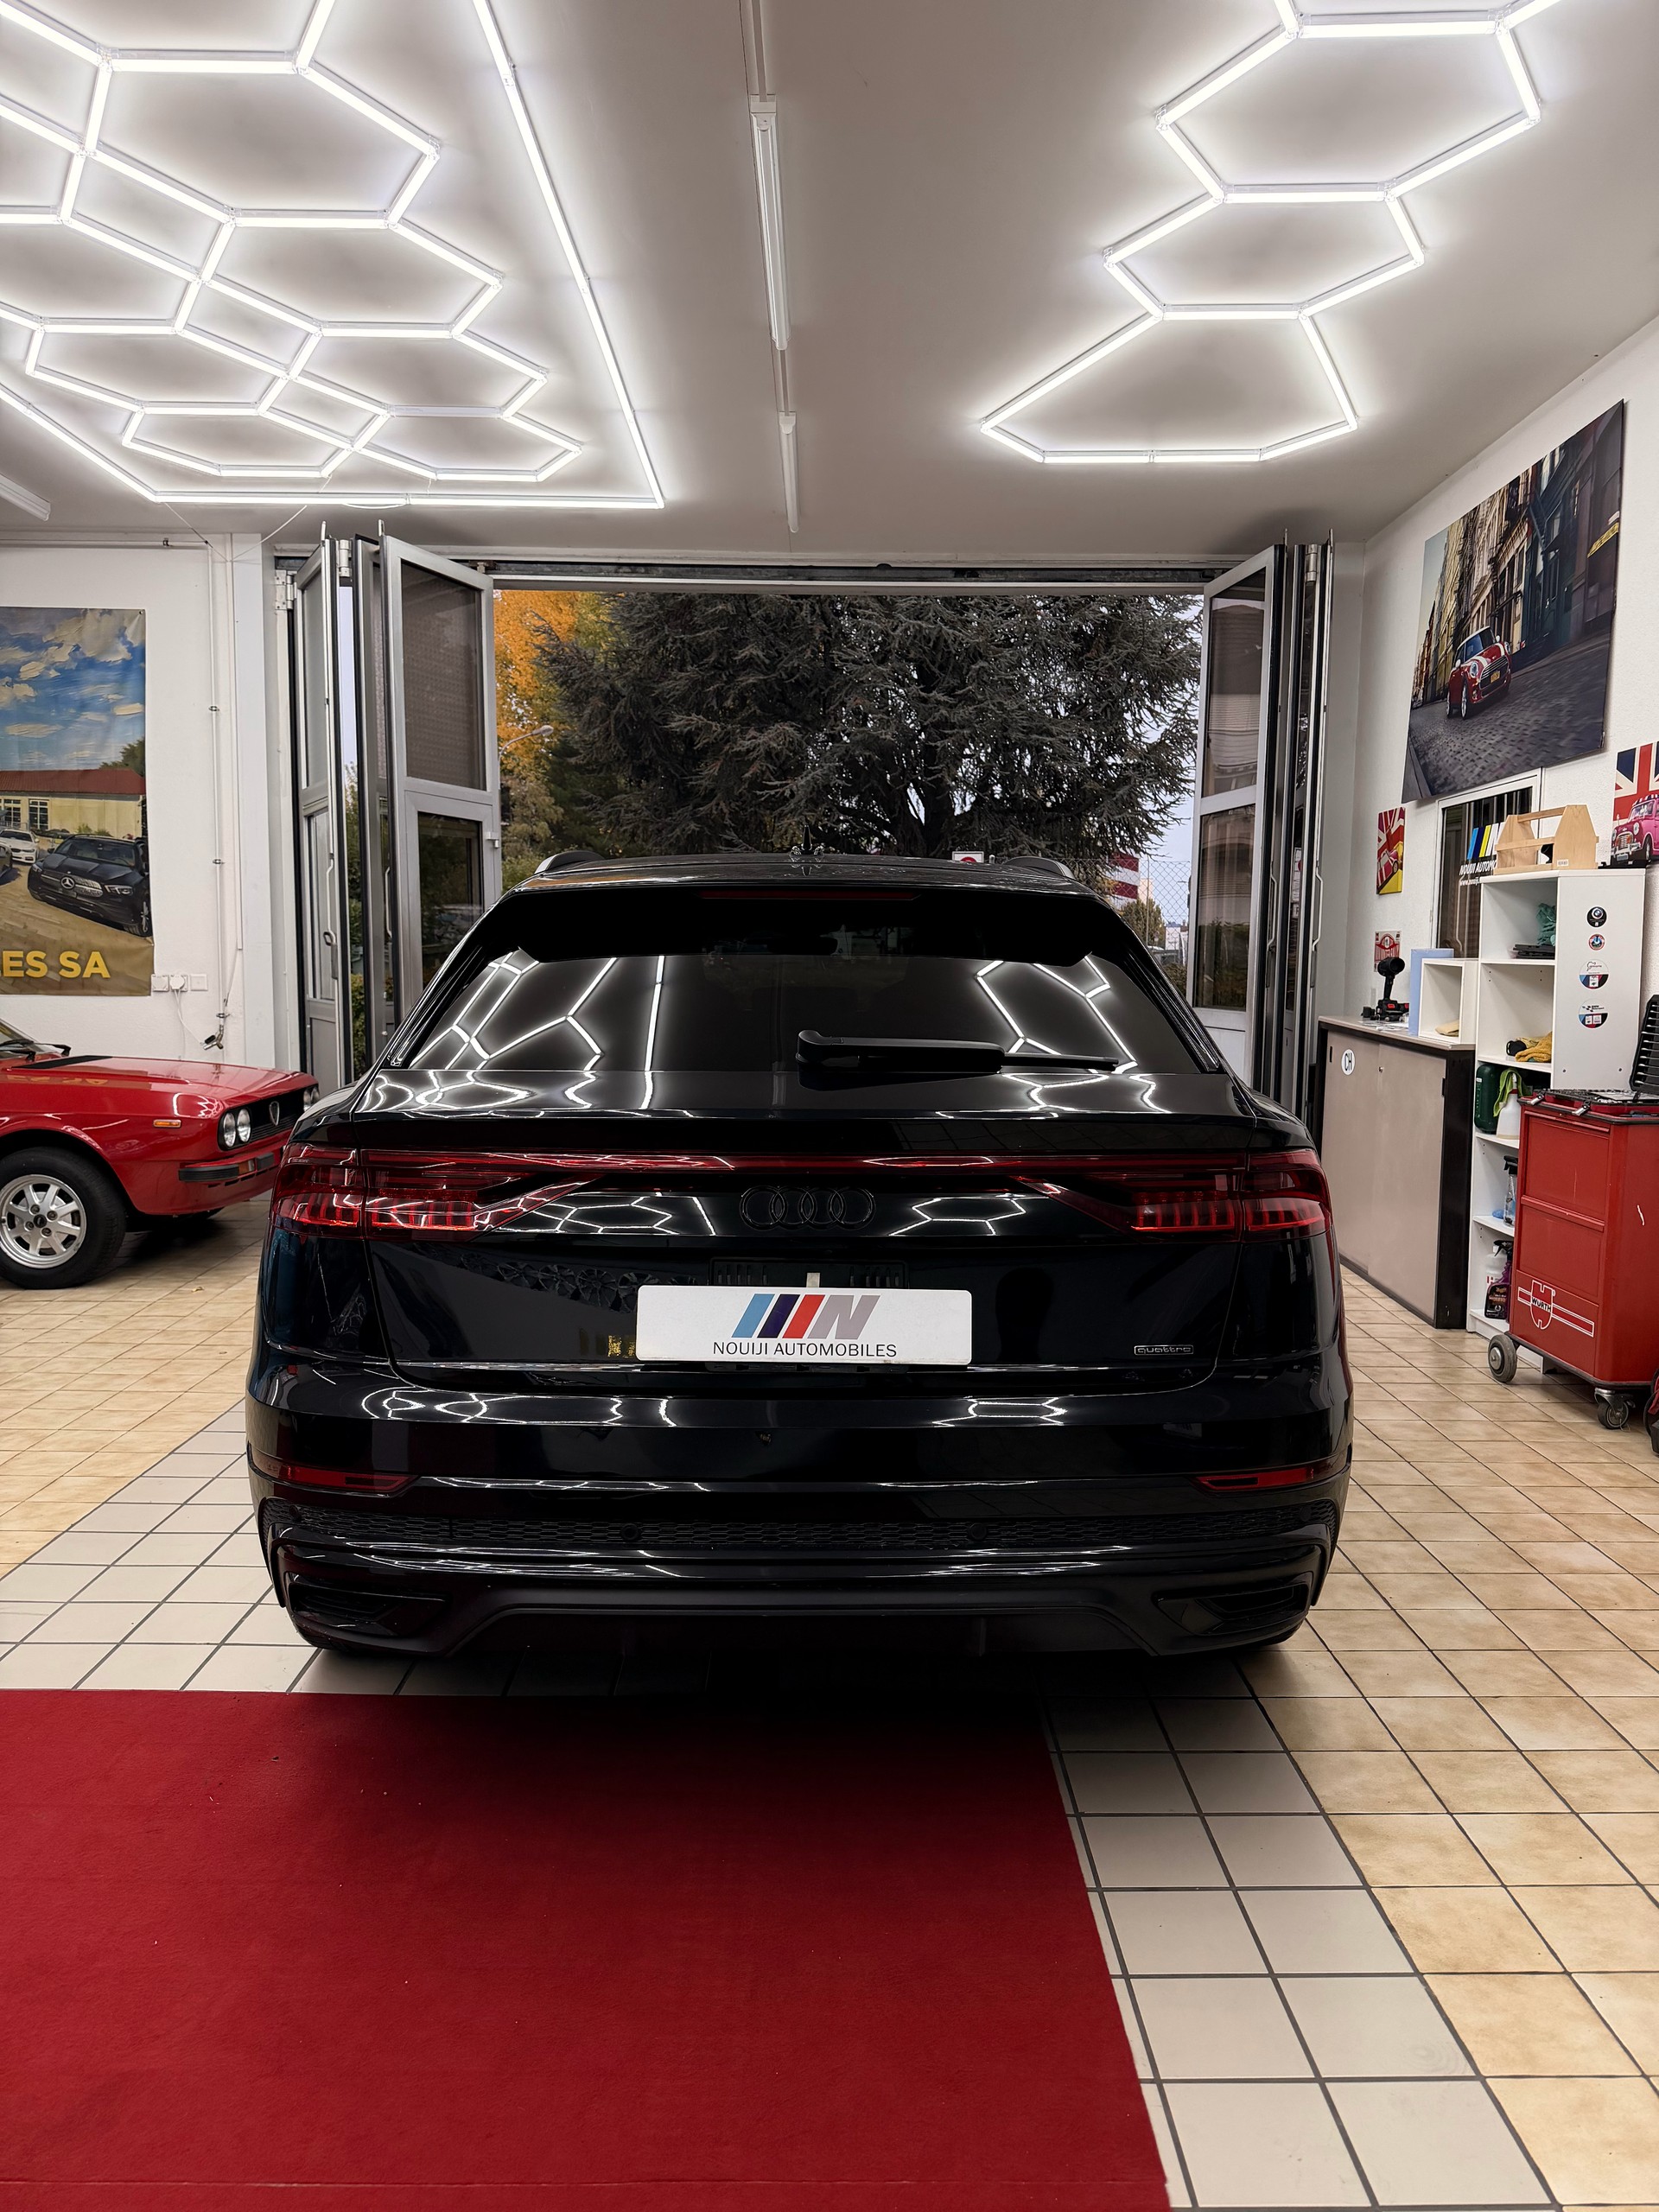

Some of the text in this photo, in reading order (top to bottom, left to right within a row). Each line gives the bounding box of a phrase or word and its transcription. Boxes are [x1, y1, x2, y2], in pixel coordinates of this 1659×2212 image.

[1475, 860, 1497, 873] AUTOMO
[0, 950, 111, 978] ES SA
[1344, 1052, 1352, 1071] CH
[713, 1341, 897, 1357] NOUIJI AUTOMOBILES
